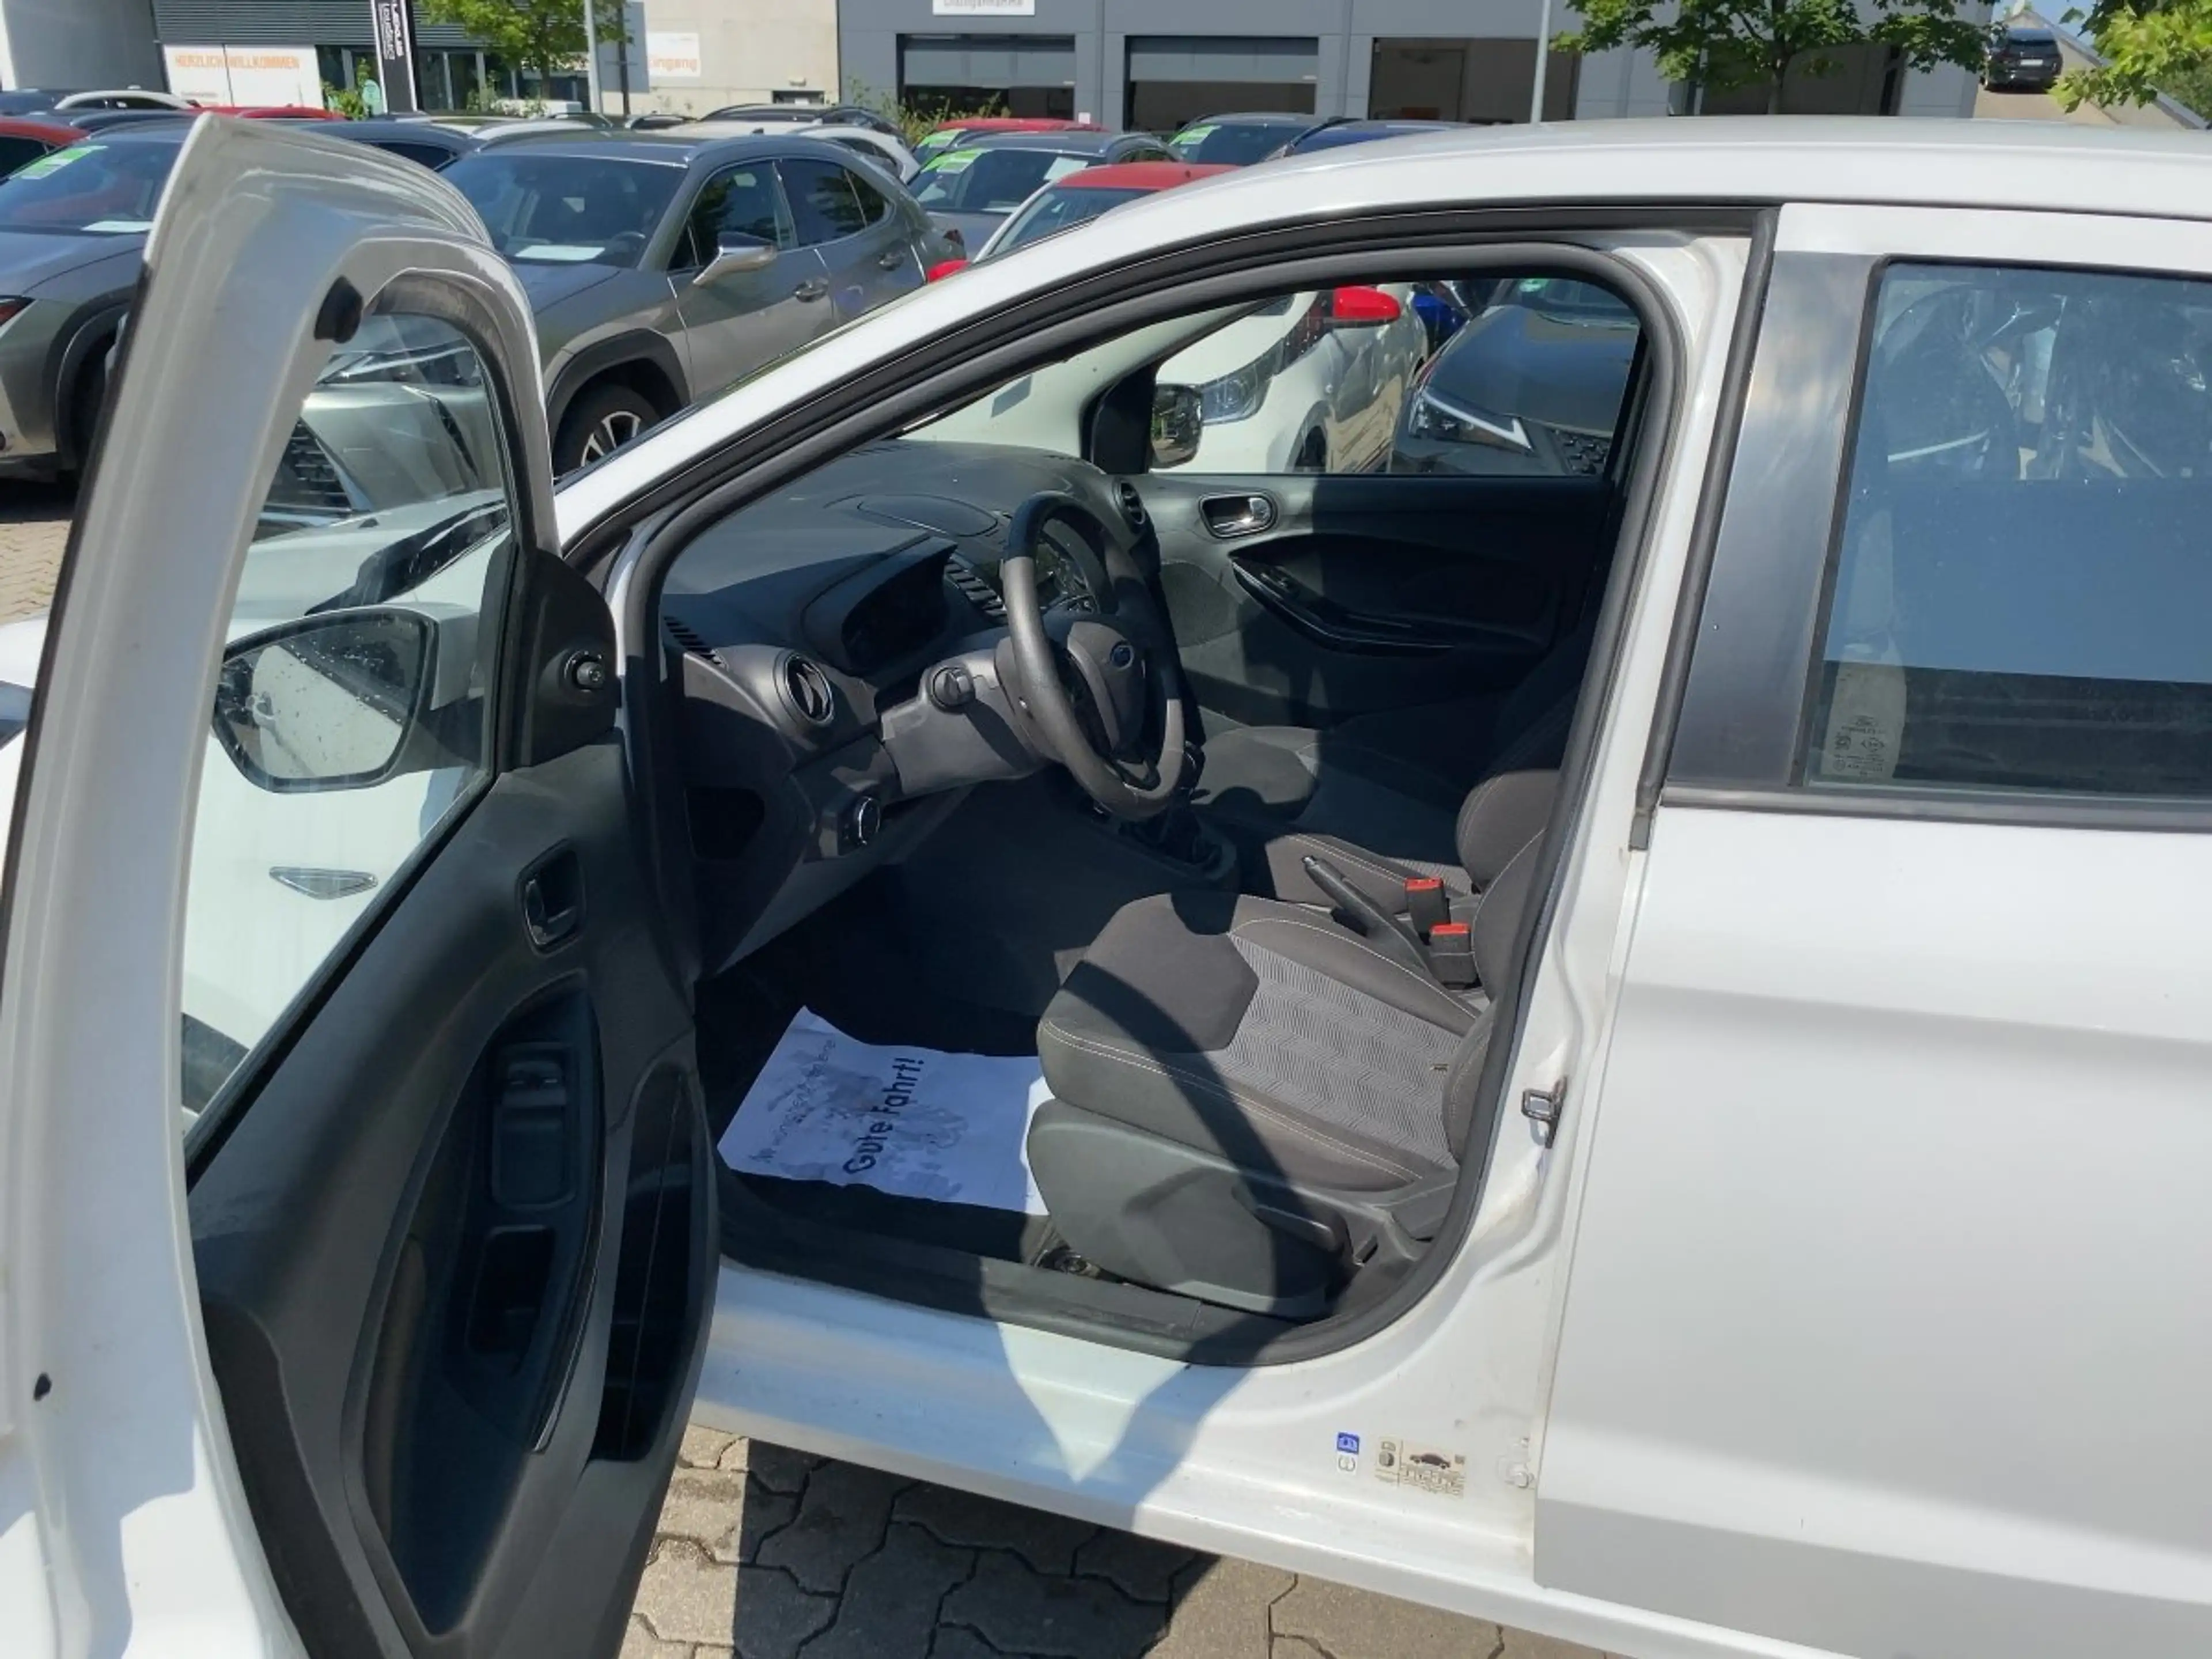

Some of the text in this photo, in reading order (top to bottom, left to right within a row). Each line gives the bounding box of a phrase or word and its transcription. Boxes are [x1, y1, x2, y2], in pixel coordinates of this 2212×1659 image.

[175, 54, 300, 69] HERZLICH WILLKOMMEN
[843, 1058, 925, 1175] Gute Fahrt!
